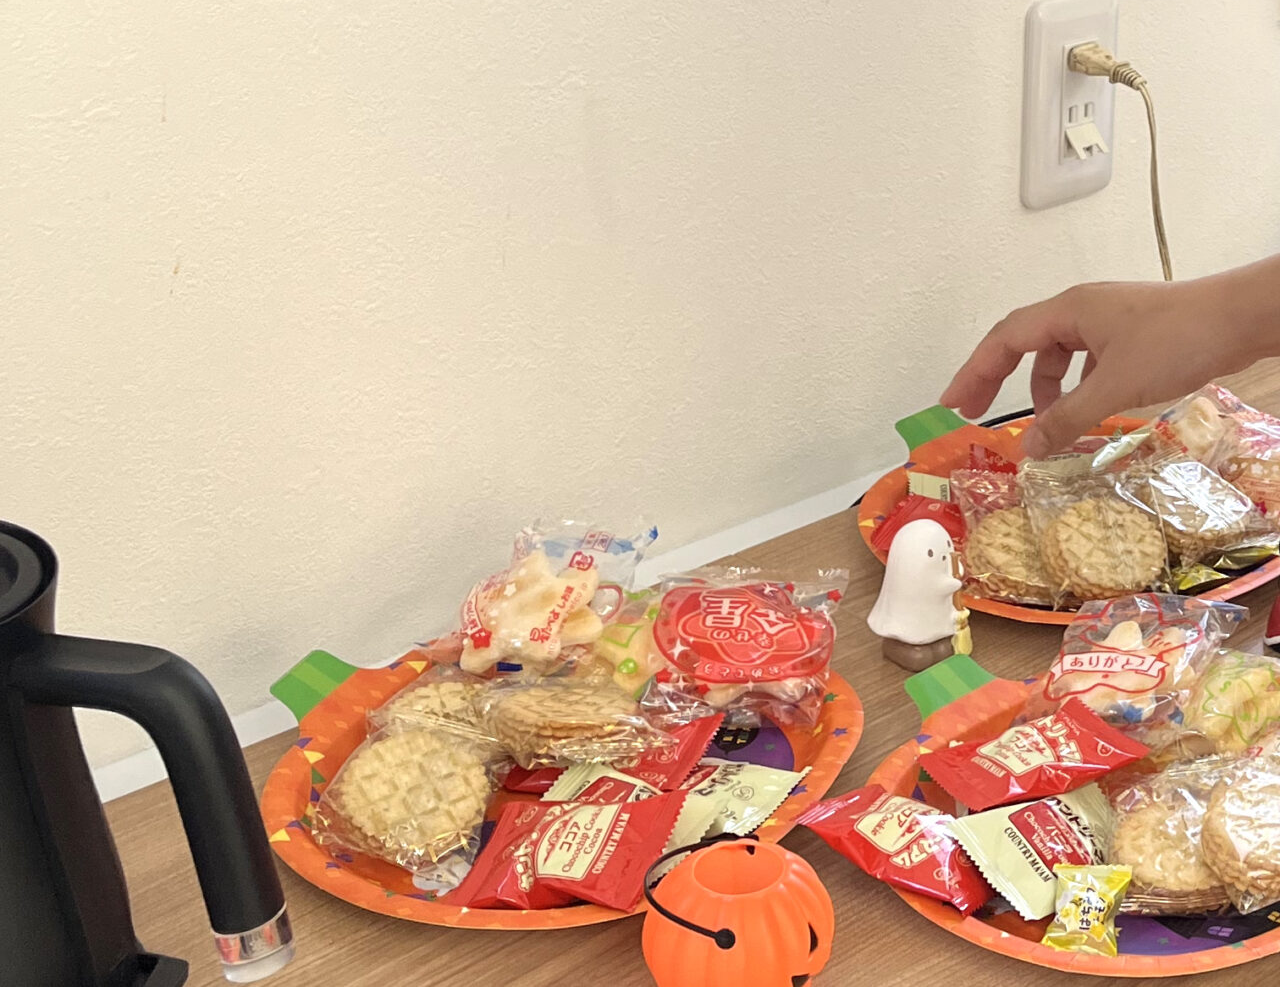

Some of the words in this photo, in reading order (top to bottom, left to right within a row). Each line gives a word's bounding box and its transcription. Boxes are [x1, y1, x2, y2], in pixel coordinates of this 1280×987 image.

[559, 821, 582, 854] ココア
[871, 812, 896, 836] Cookie
[583, 827, 603, 855] Cocoa
[1031, 834, 1054, 861] Vanilla
[1046, 824, 1074, 854] バニラ
[1004, 826, 1034, 862] COUNTRY
[1028, 857, 1053, 883] MA'AM
